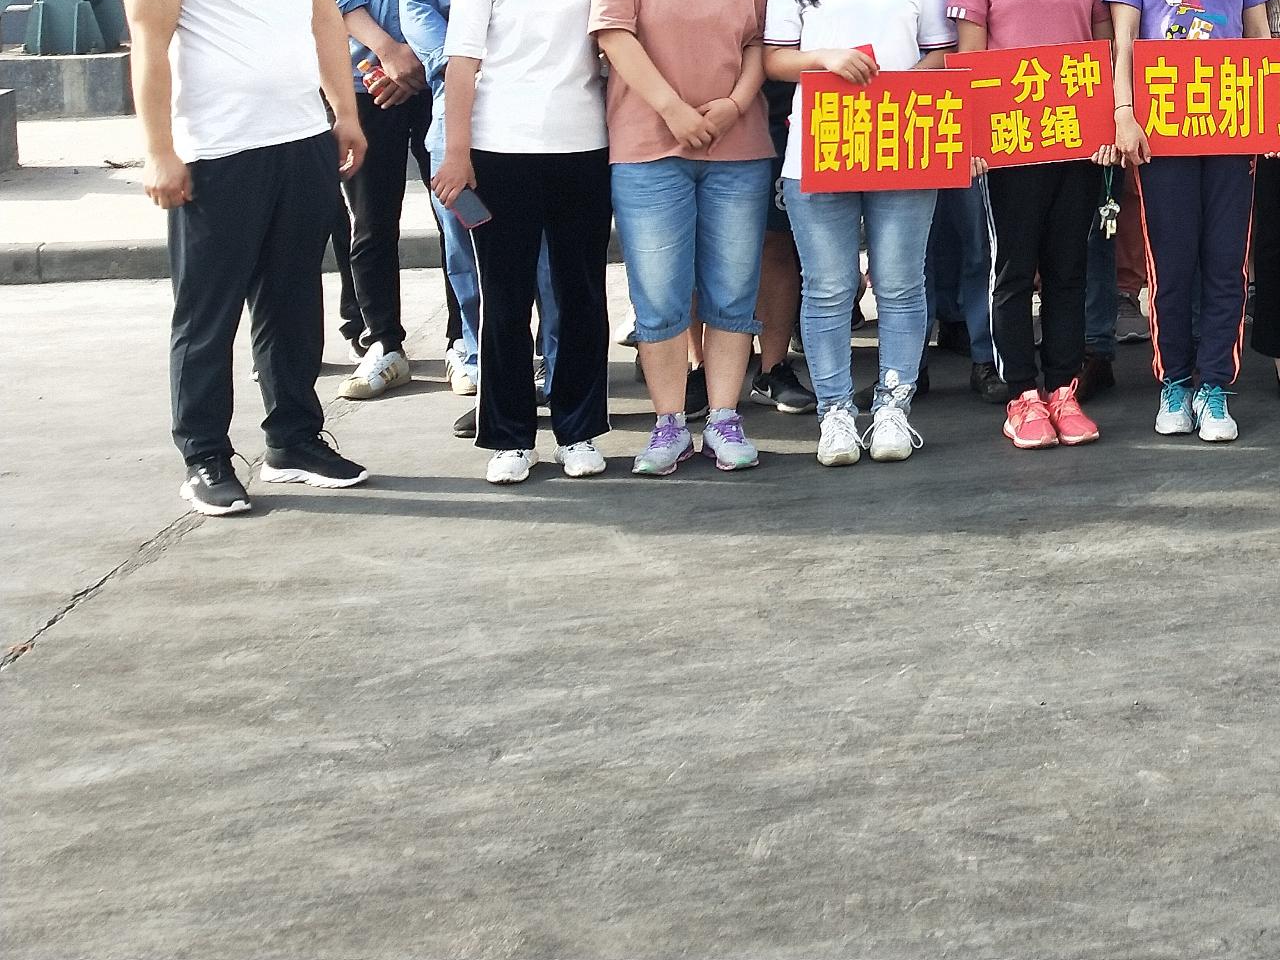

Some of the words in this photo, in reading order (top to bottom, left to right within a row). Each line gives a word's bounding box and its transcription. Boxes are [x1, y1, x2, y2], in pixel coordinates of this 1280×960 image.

[970, 53, 1101, 103] 一分钟
[810, 89, 963, 172] 慢骑自行车
[990, 105, 1083, 155] 跳绳
